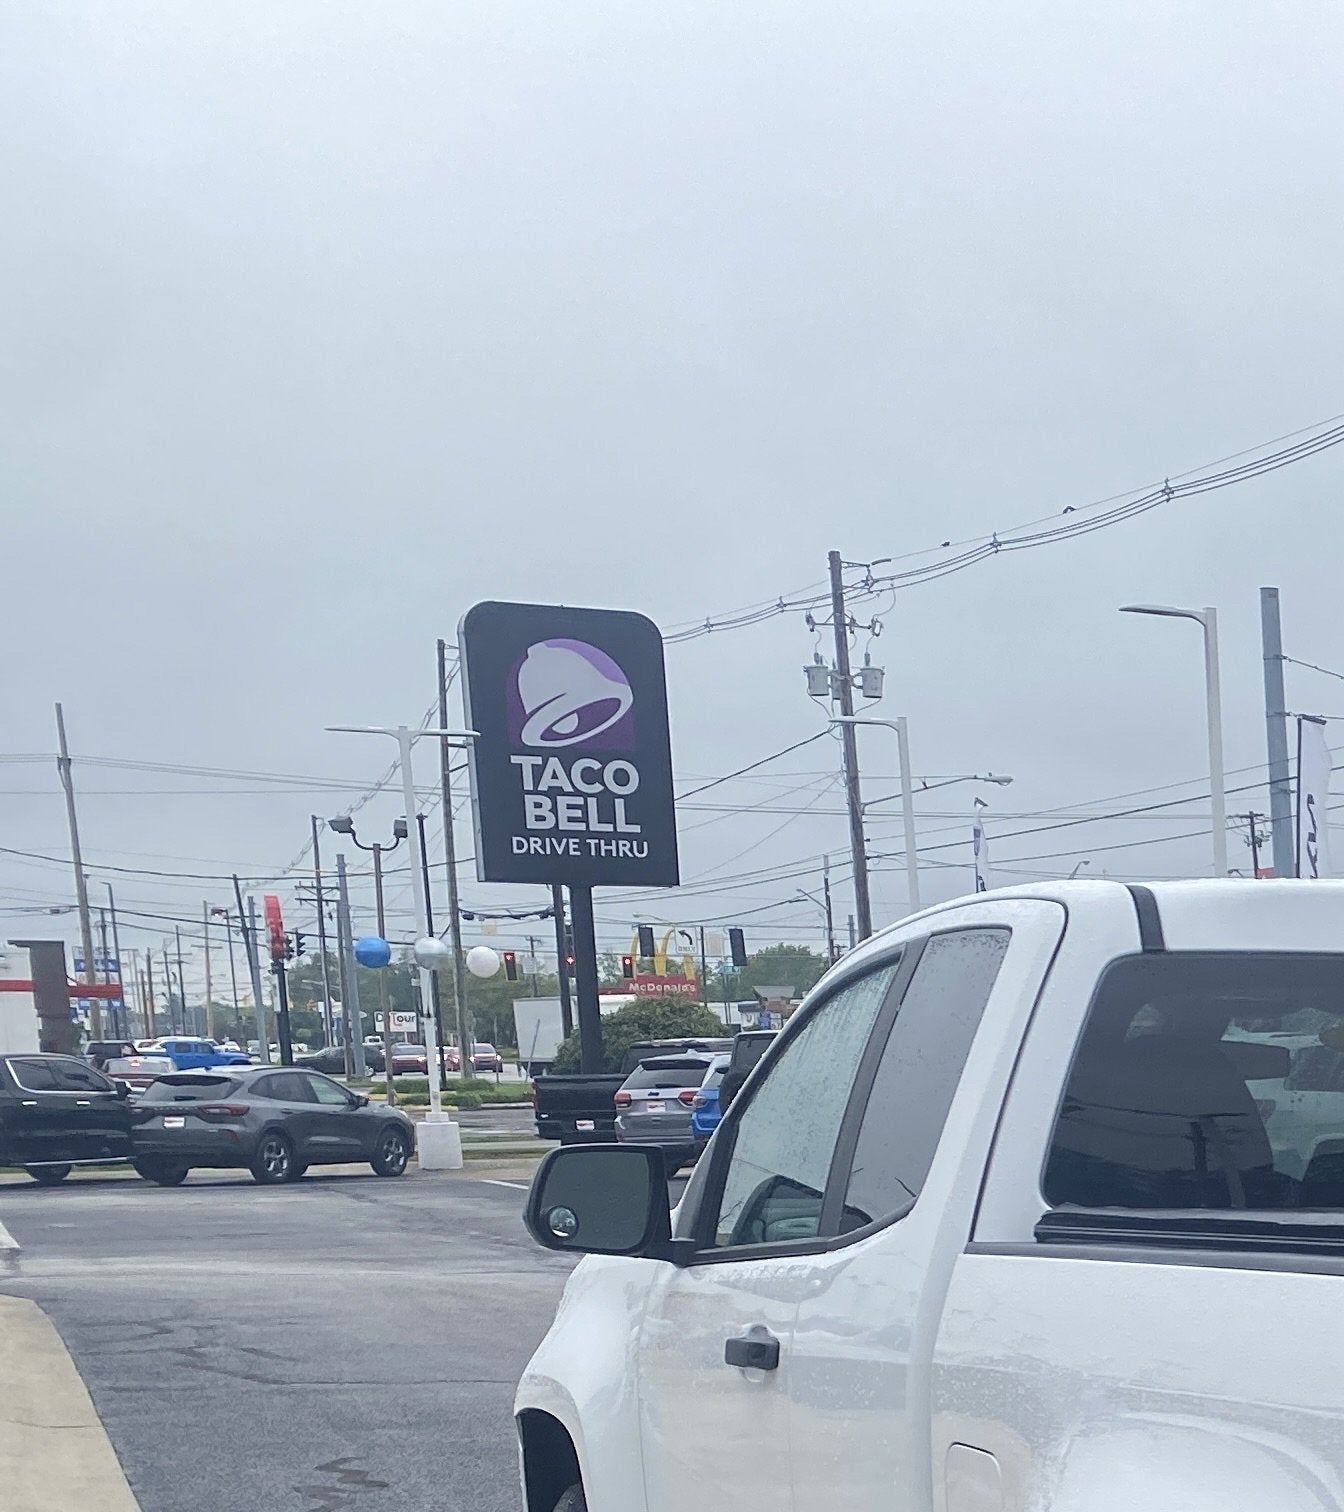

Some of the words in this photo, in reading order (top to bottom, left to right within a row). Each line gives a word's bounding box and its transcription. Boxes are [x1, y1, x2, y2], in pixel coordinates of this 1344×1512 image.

[510, 755, 640, 795] TACO
[524, 795, 642, 833] BELL
[511, 837, 581, 856] DRIVE
[586, 839, 649, 858] THRU
[628, 983, 697, 993] McDonald's
